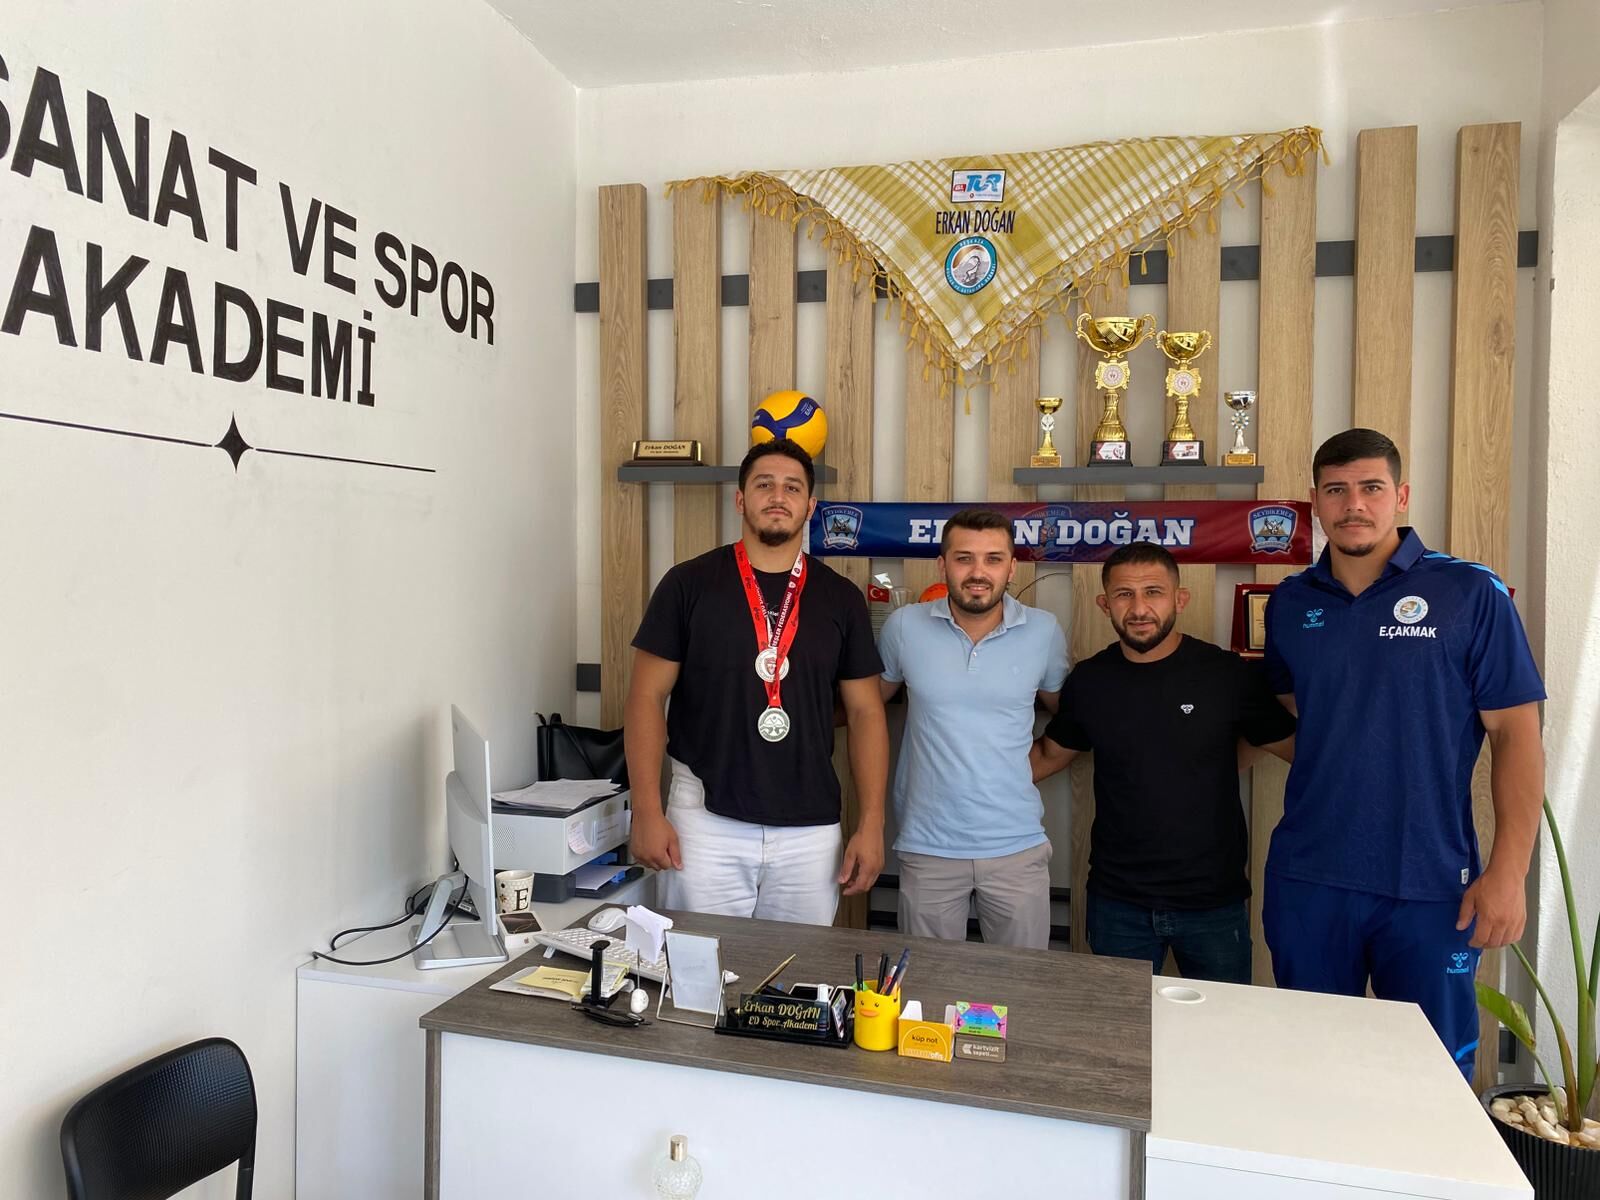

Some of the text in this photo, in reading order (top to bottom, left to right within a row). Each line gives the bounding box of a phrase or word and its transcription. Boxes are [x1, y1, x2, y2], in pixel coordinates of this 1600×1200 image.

[0, 54, 494, 345] ANAT VE SPOR
[935, 206, 1016, 234] ERKAN DOĞAN
[0, 225, 376, 407] AKADEMİ
[1056, 511, 1194, 545] DOĞAN
[1379, 625, 1437, 639] E.ÇAKMAK
[512, 887, 529, 912] E
[1446, 966, 1469, 974] hummel
[744, 1000, 821, 1020] Erkan DOĞAN
[748, 1016, 760, 1025] ED
